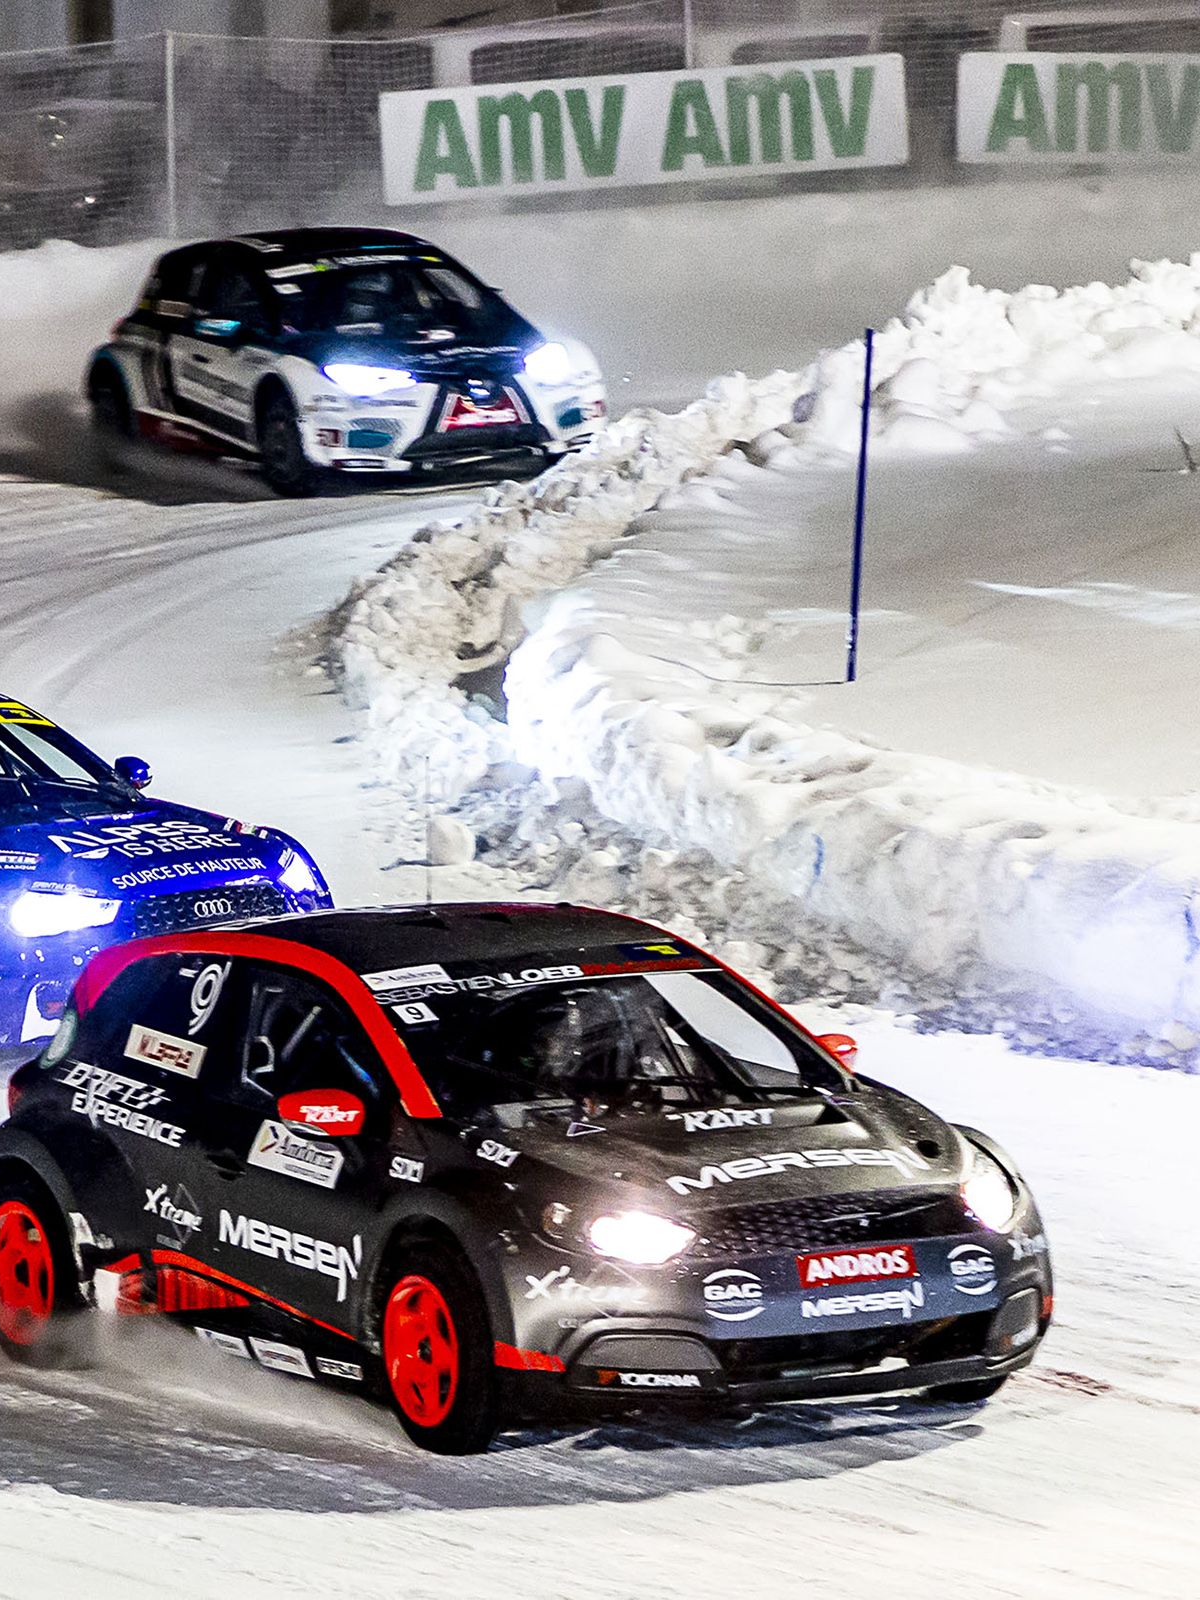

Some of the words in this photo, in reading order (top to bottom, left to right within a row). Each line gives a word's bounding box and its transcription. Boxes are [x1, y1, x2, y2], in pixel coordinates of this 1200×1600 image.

[47, 820, 210, 853] ALPES
[112, 842, 154, 858] IS
[145, 833, 242, 853] HERE
[112, 865, 174, 890] SOURCE
[177, 860, 200, 877] DE
[195, 856, 266, 873] HAUTEUR
[498, 965, 585, 985] LOEB
[188, 962, 228, 1036] 9
[406, 1006, 424, 1021] 9
[684, 1108, 775, 1132] KART
[806, 1249, 910, 1283] ANDROS
